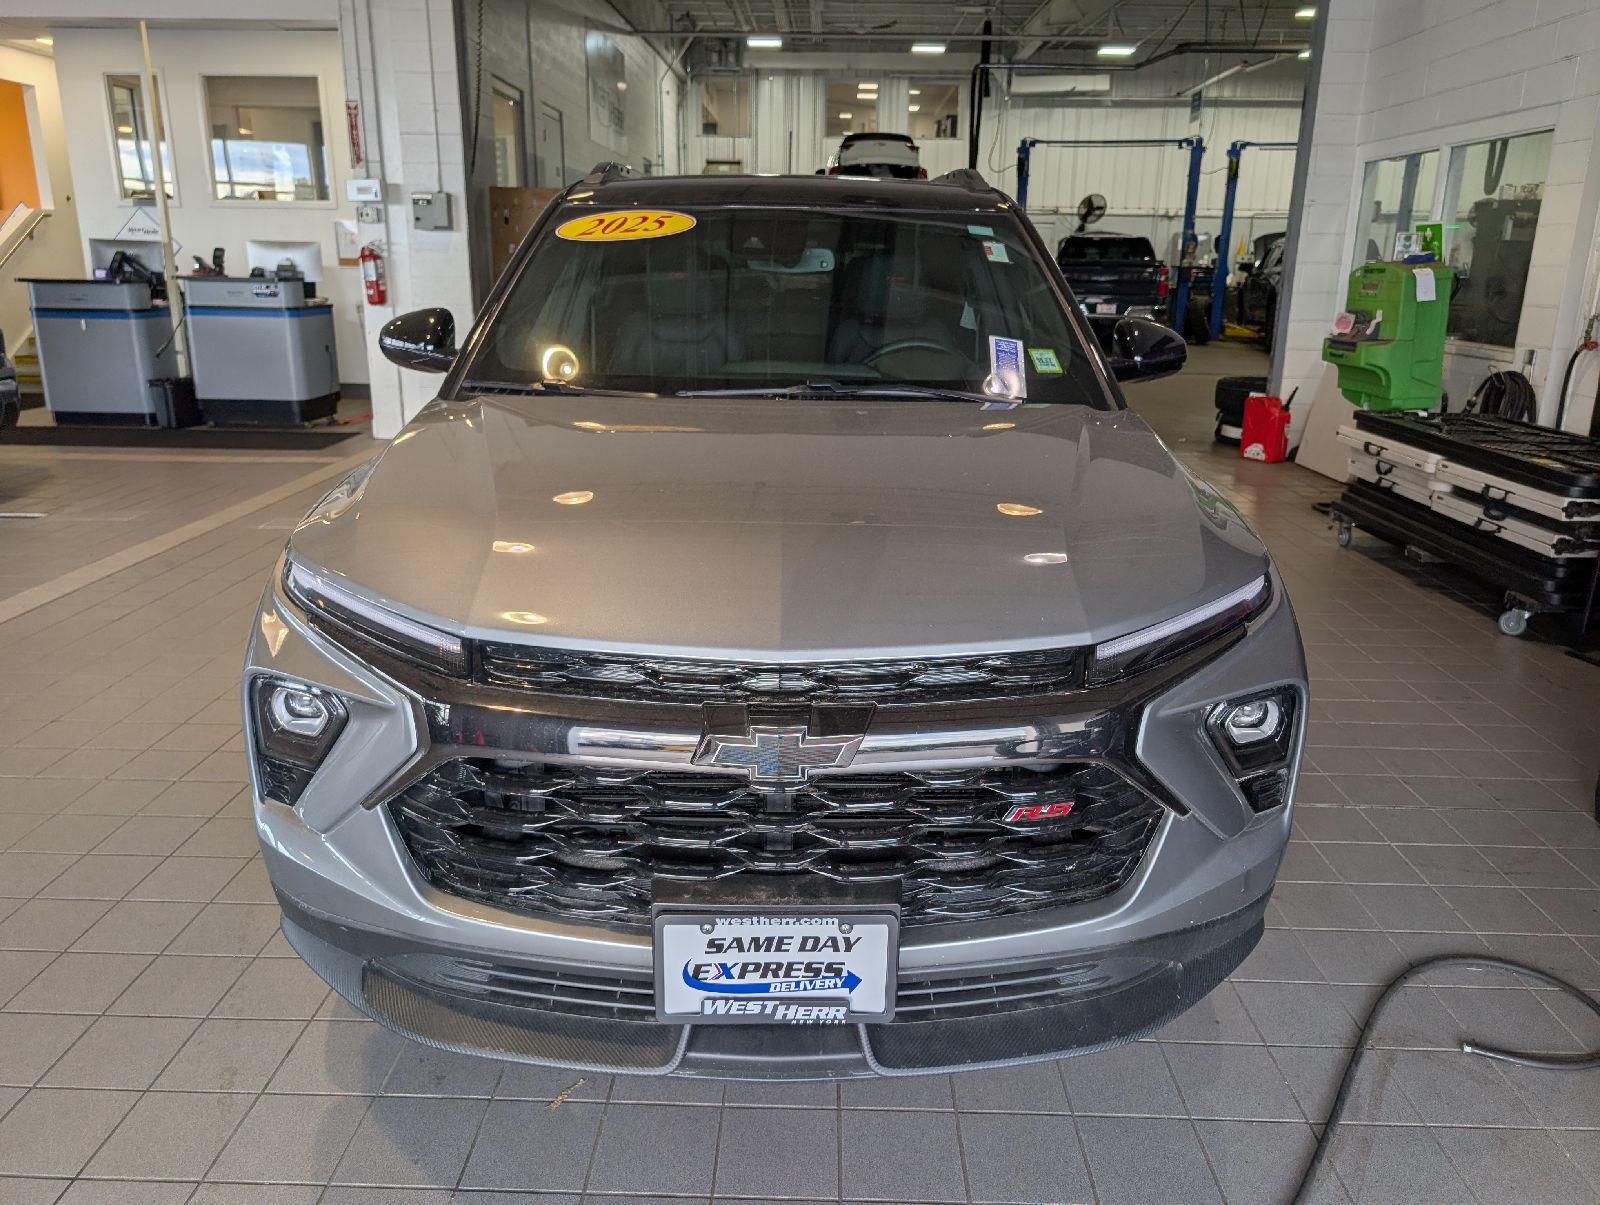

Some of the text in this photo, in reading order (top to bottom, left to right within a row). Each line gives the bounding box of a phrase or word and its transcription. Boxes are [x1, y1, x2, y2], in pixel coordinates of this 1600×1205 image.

[576, 215, 673, 237] 2025
[1002, 801, 1075, 821] RS
[715, 916, 839, 927] westherr.com
[705, 935, 862, 954] SAME DAY
[692, 961, 846, 981] EXPRESS
[769, 977, 845, 993] DELIVERY
